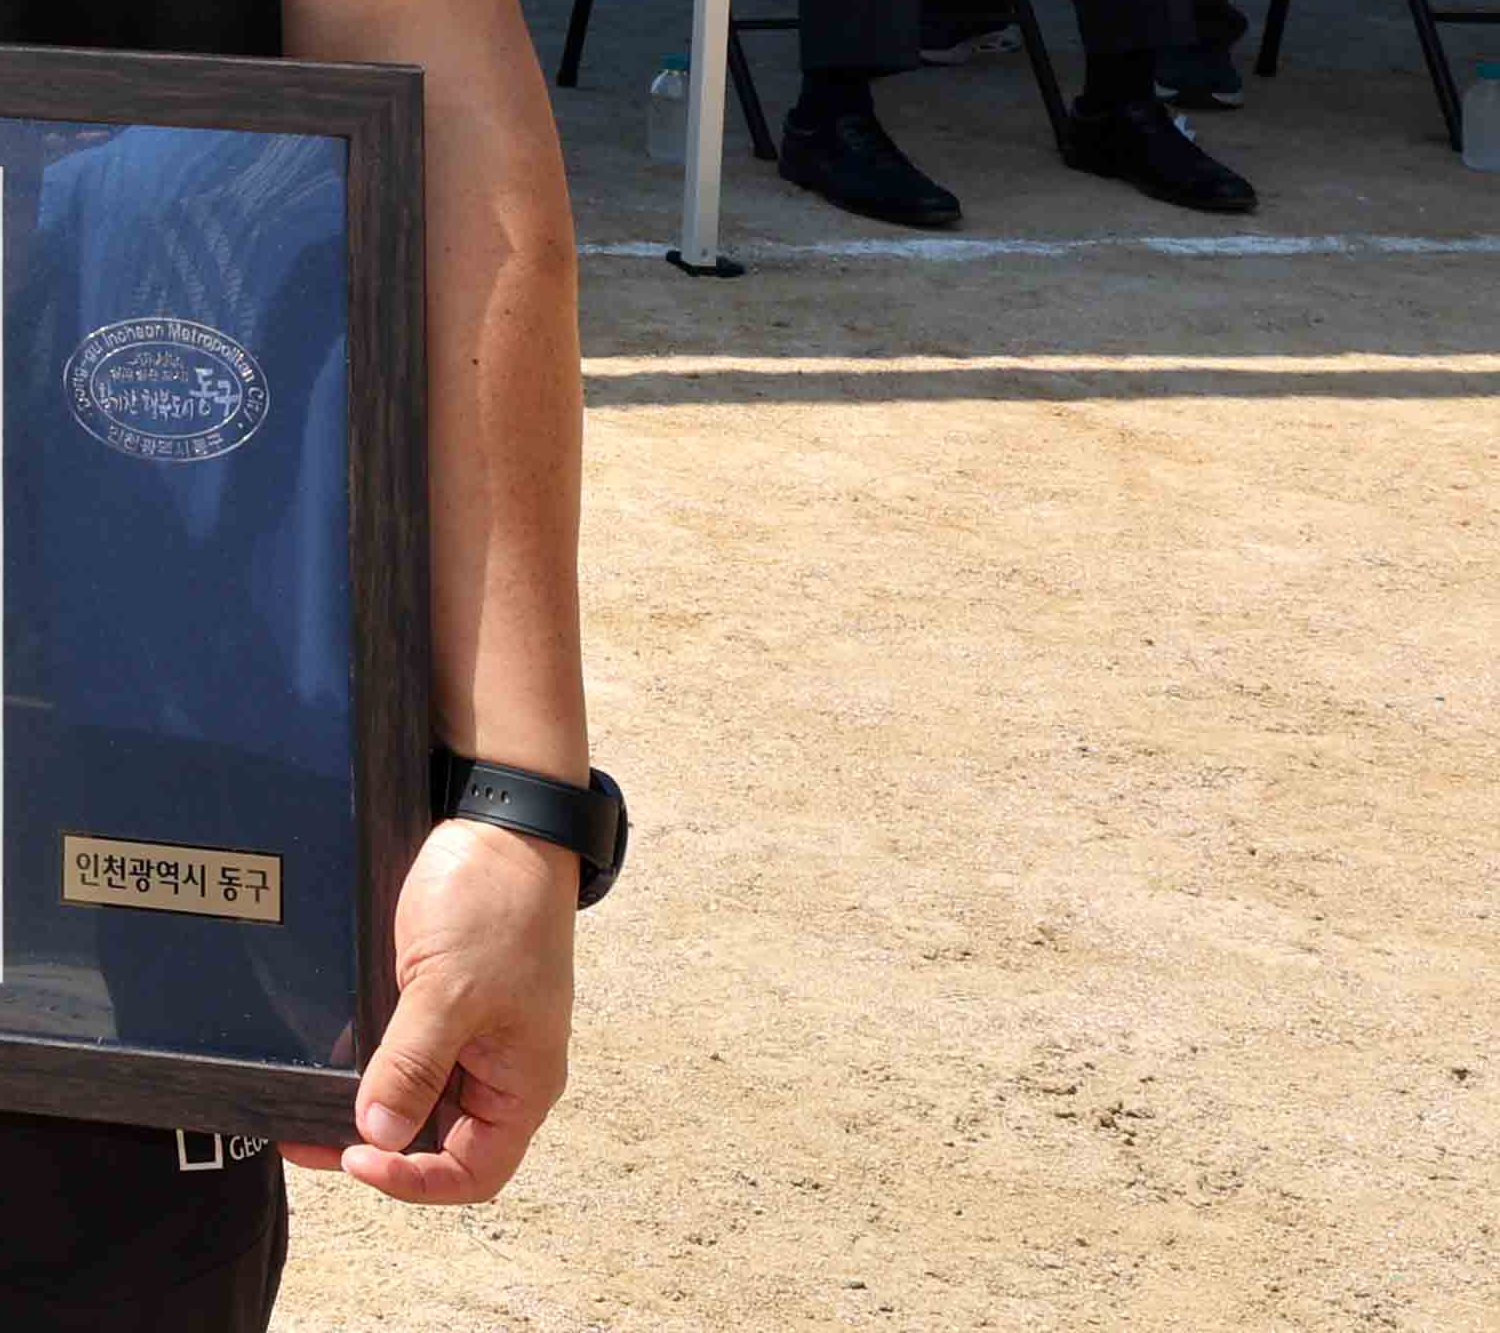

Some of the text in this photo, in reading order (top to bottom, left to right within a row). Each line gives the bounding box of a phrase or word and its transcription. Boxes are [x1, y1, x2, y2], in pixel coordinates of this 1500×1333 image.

[75, 852, 272, 901] 인천광역시 동구
[229, 1134, 268, 1161] GEO
